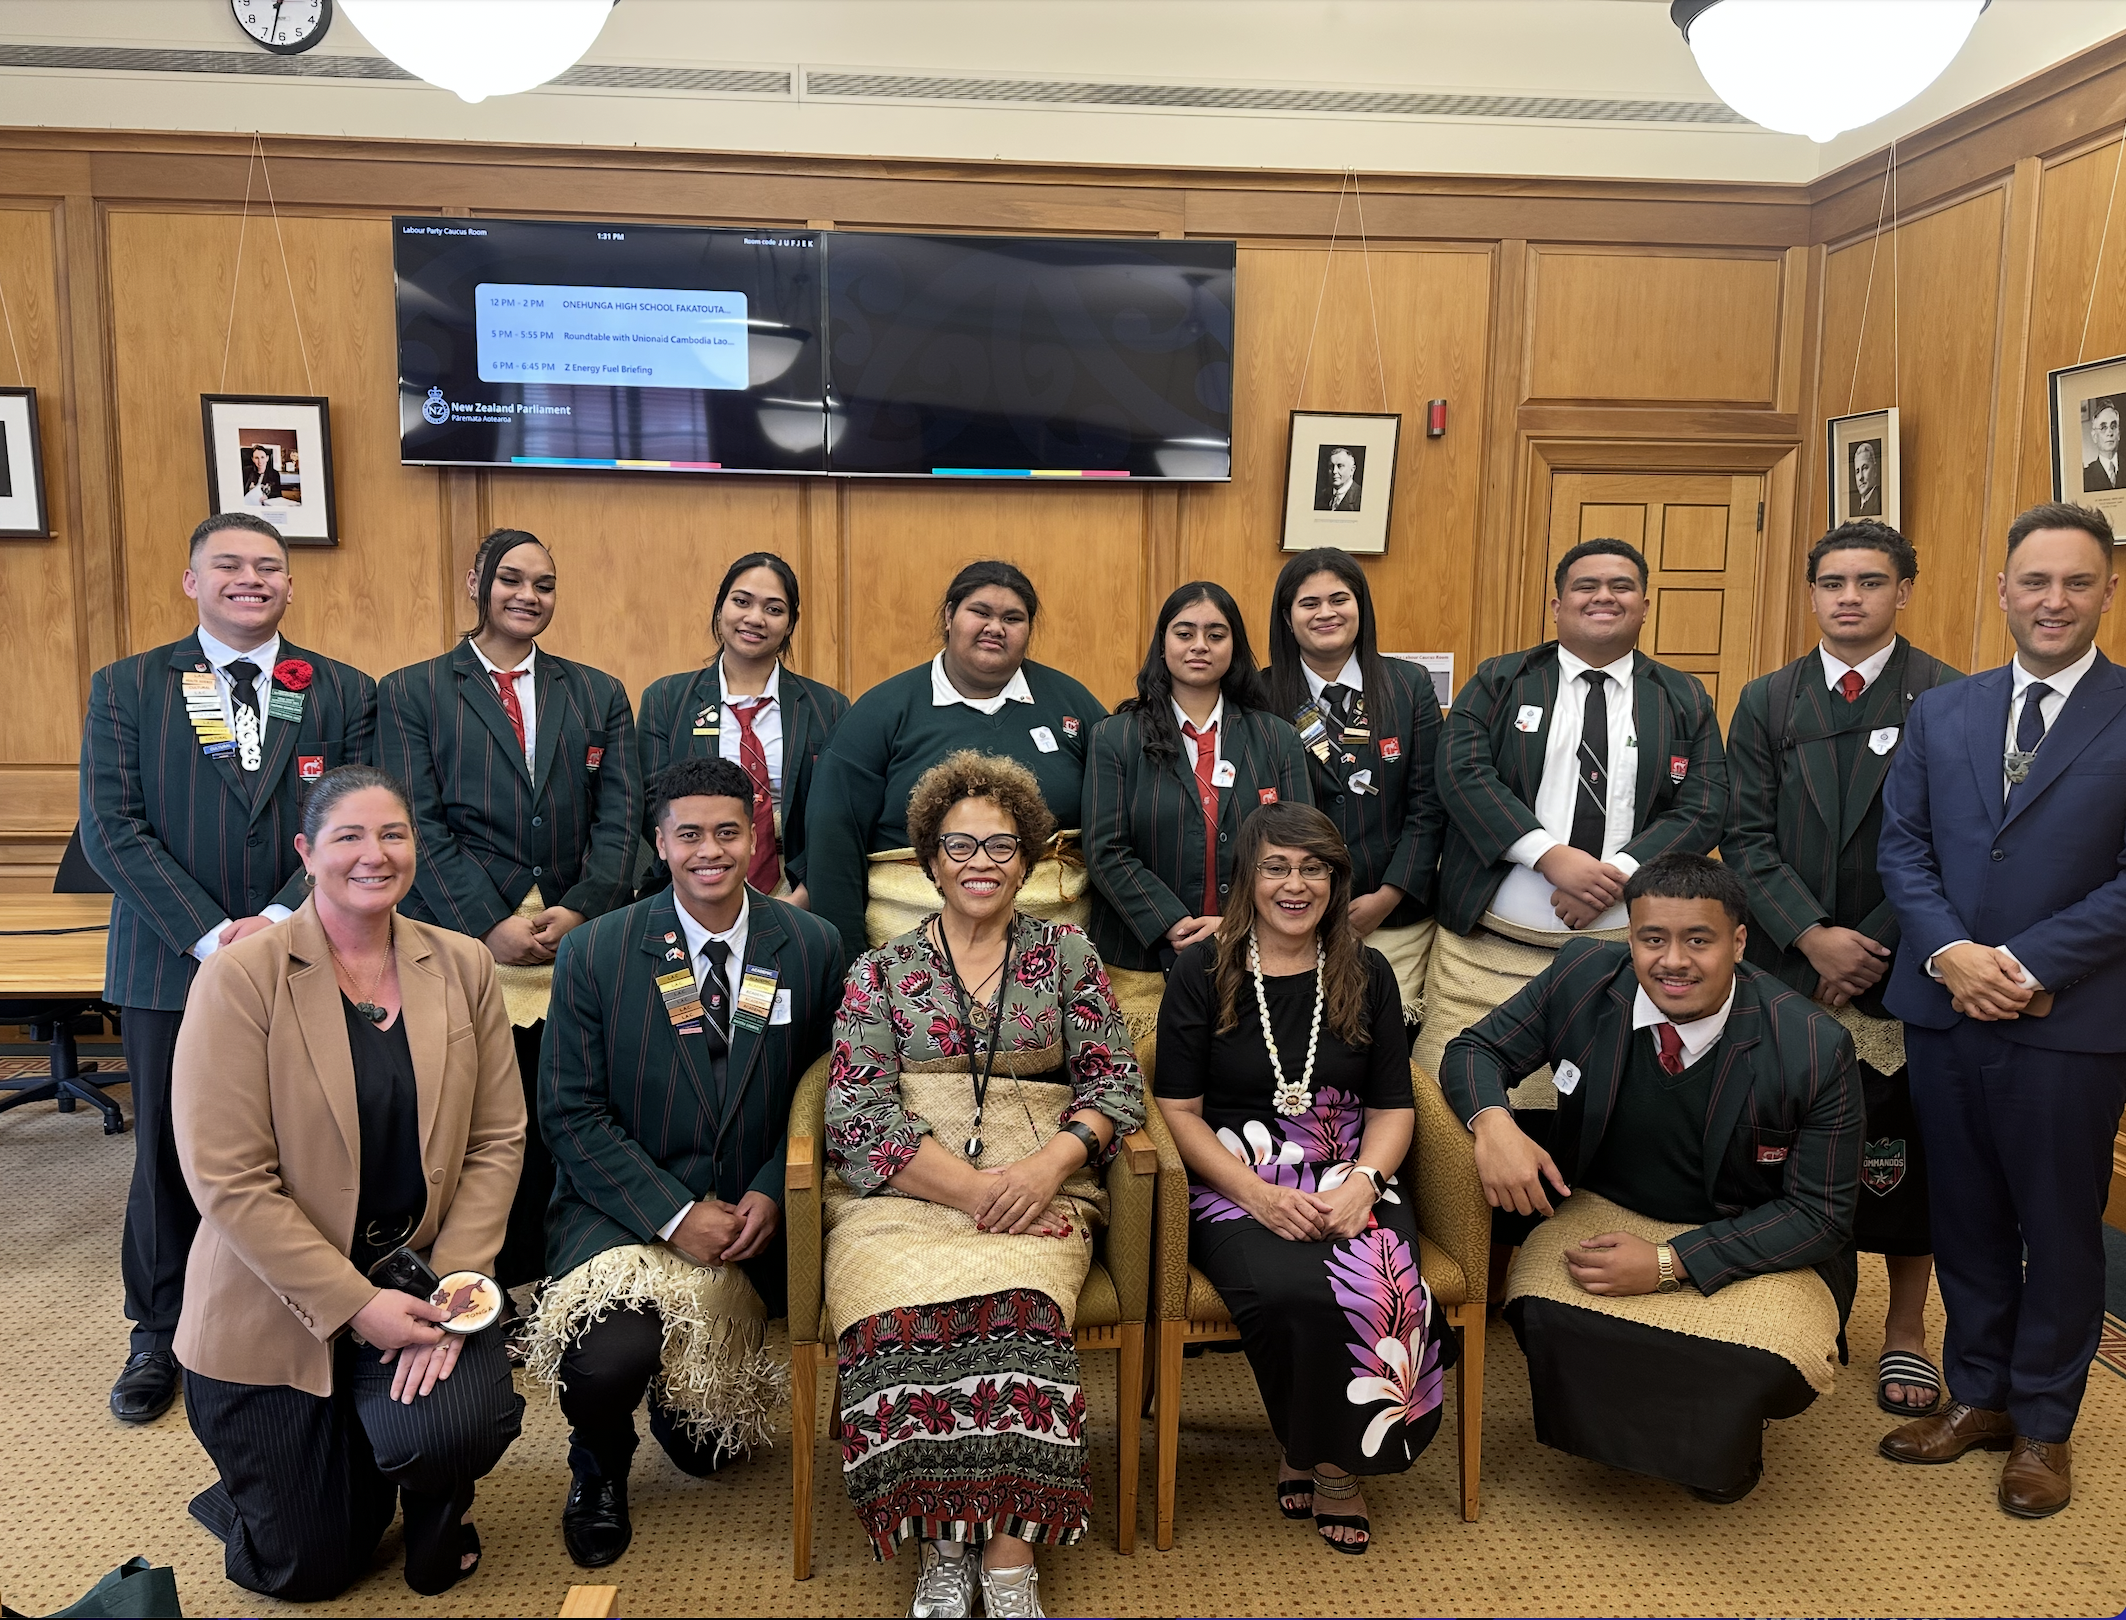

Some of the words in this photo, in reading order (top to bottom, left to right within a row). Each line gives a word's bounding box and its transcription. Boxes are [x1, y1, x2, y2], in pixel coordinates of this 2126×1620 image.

[248, 14, 256, 23] 8
[308, 16, 315, 24] 4
[262, 27, 268, 36] 7
[295, 28, 302, 36] 5
[279, 32, 286, 41] 6
[426, 228, 442, 236] Party
[563, 300, 613, 310] ONEHUNGA
[639, 303, 674, 312] SCHOOL
[564, 332, 610, 341] Roundtable
[612, 333, 630, 342] with
[632, 334, 668, 343] Unionaid
[671, 335, 712, 344] Cambodia
[522, 362, 539, 370] 6:45
[572, 364, 600, 374] Energy
[621, 365, 652, 376] Briefing
[428, 406, 445, 415] NZ
[451, 402, 474, 412] New
[475, 403, 514, 413] Zealand
[517, 404, 571, 415] Parliament
[1863, 1159, 1904, 1167] OMMANDOS
[465, 1306, 494, 1319] TONGA
